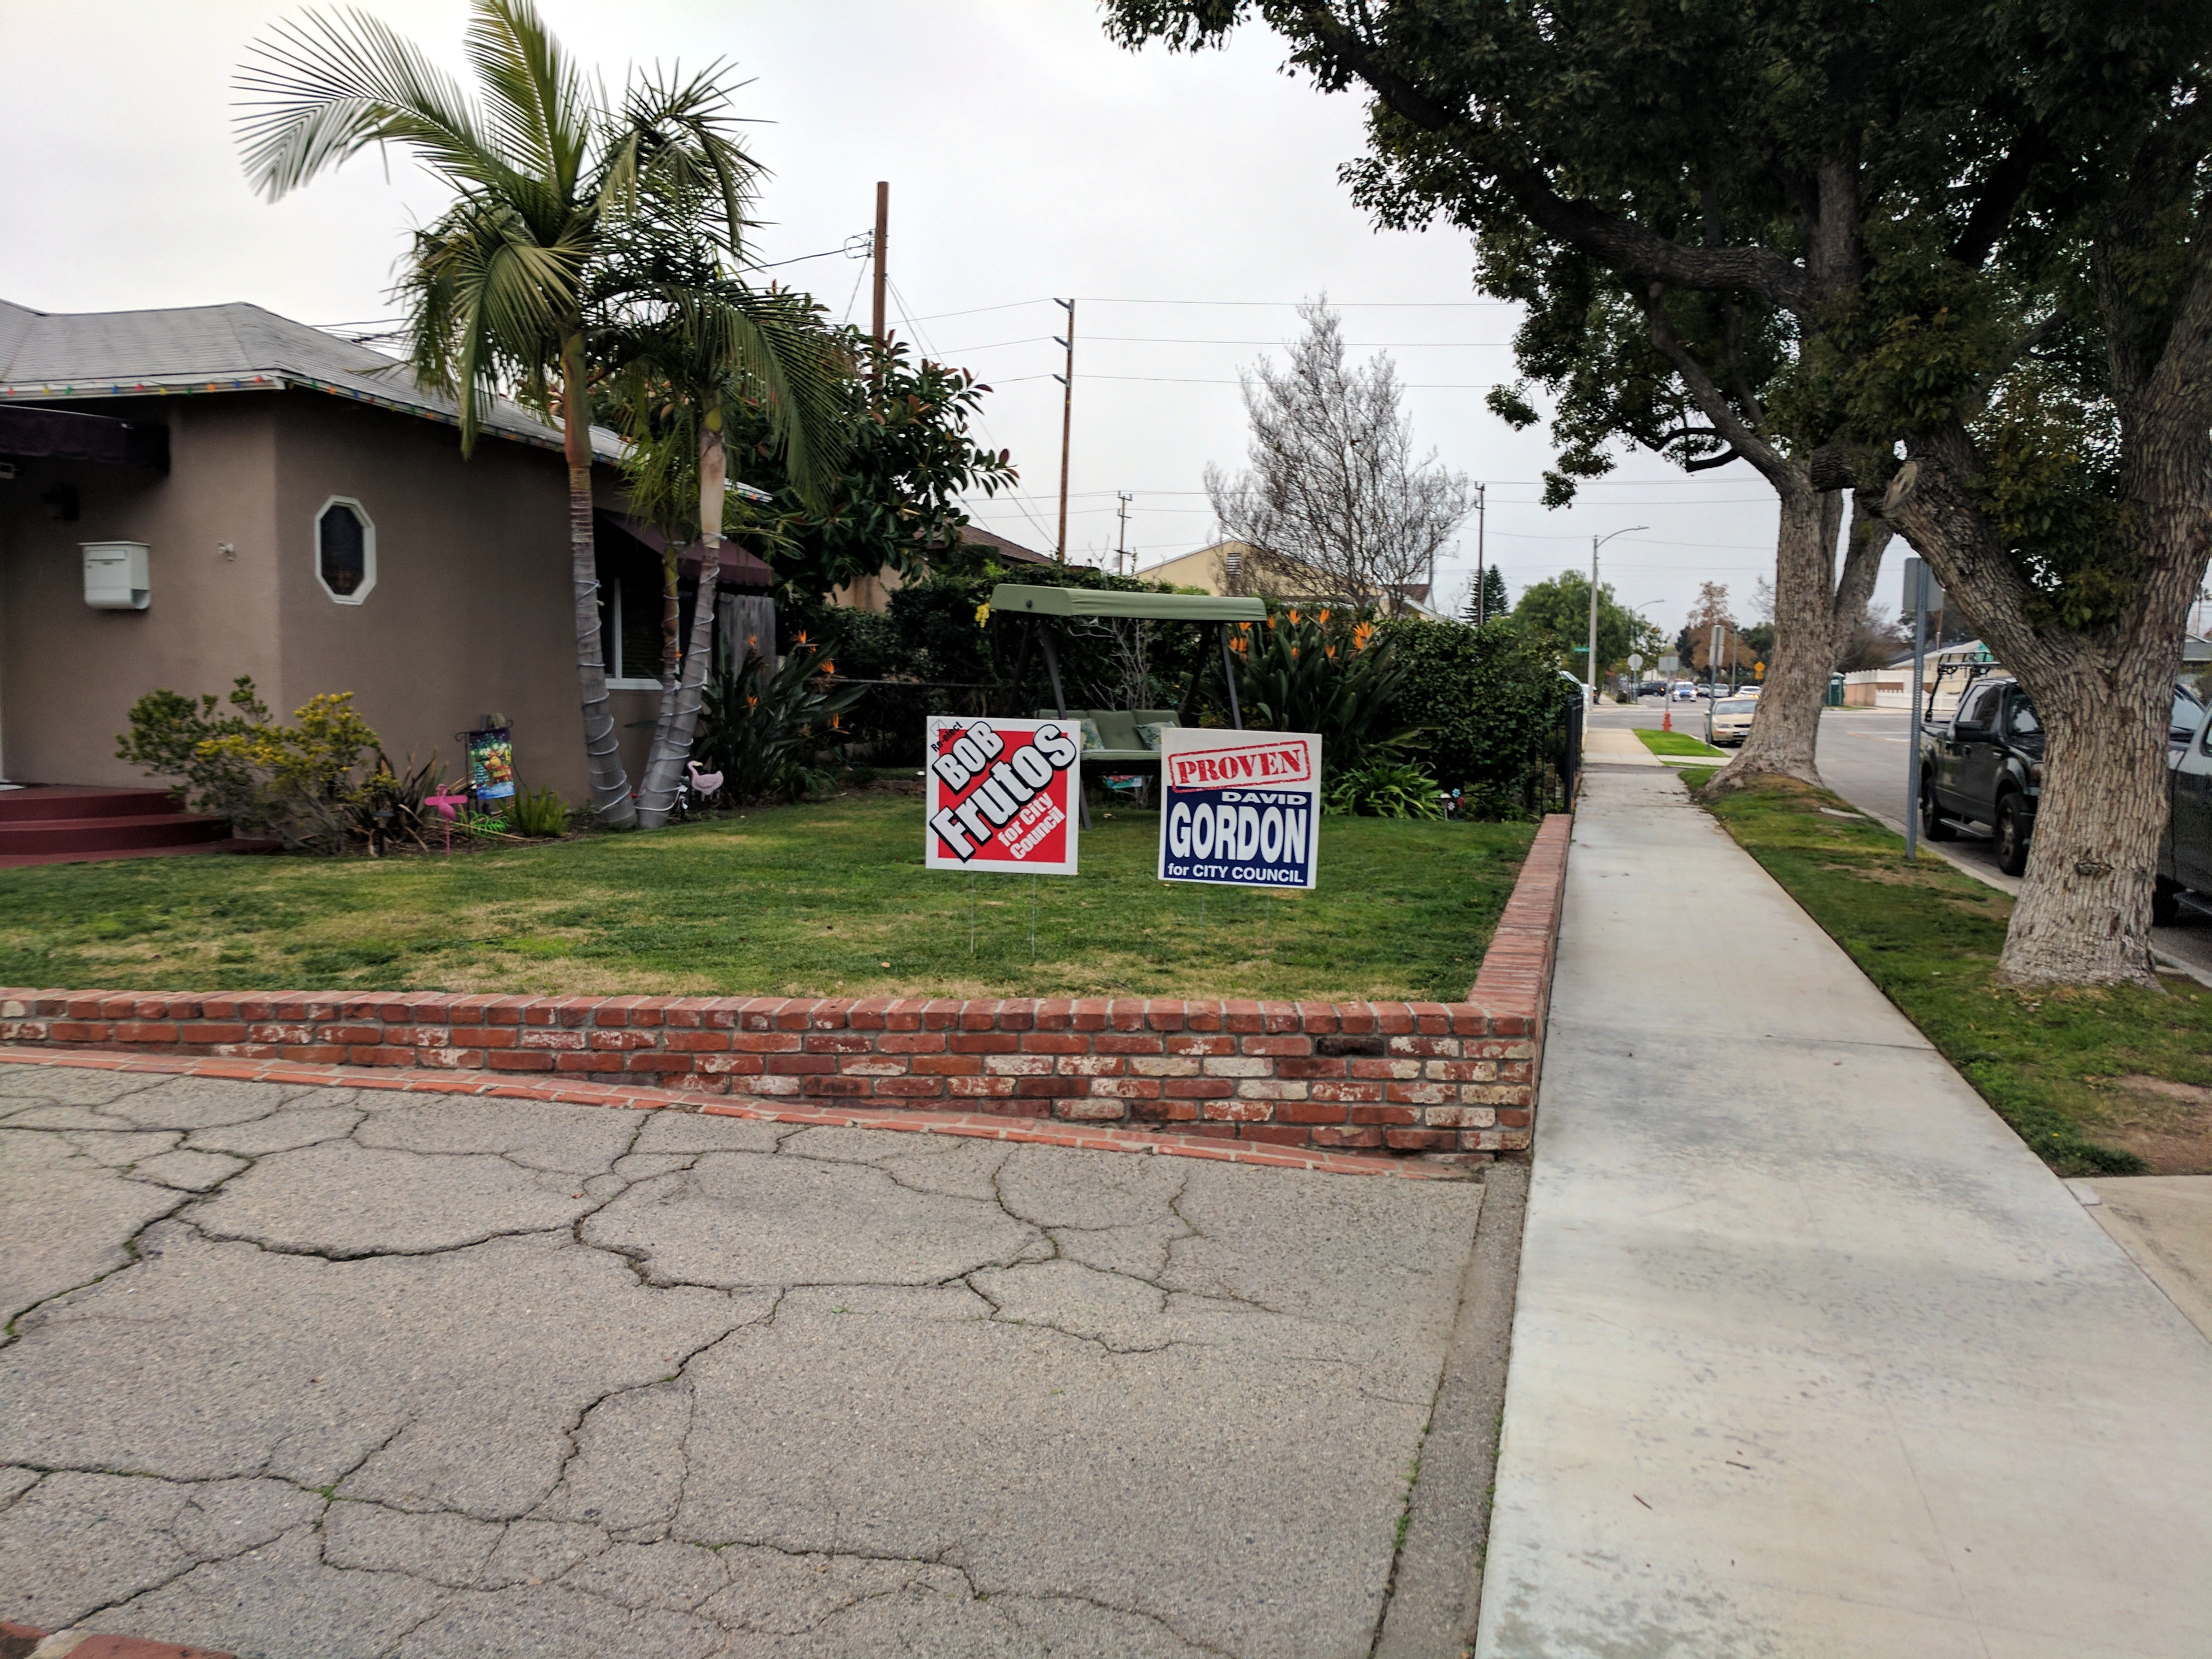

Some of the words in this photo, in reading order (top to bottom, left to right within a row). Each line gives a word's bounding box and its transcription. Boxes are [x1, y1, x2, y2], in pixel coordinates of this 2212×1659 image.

[931, 721, 963, 752] Re-elect
[932, 721, 1004, 796] BOB
[929, 724, 1076, 863] Frutos
[1176, 749, 1301, 784] PROVEN
[997, 820, 1023, 847] for
[1019, 792, 1054, 826] City
[1221, 791, 1307, 805] DAVID
[1010, 805, 1066, 860] Council
[1169, 802, 1307, 864] GORDON
[1168, 863, 1189, 876] for
[1193, 864, 1228, 878] CITY
[1232, 867, 1304, 883] COUNCIL
